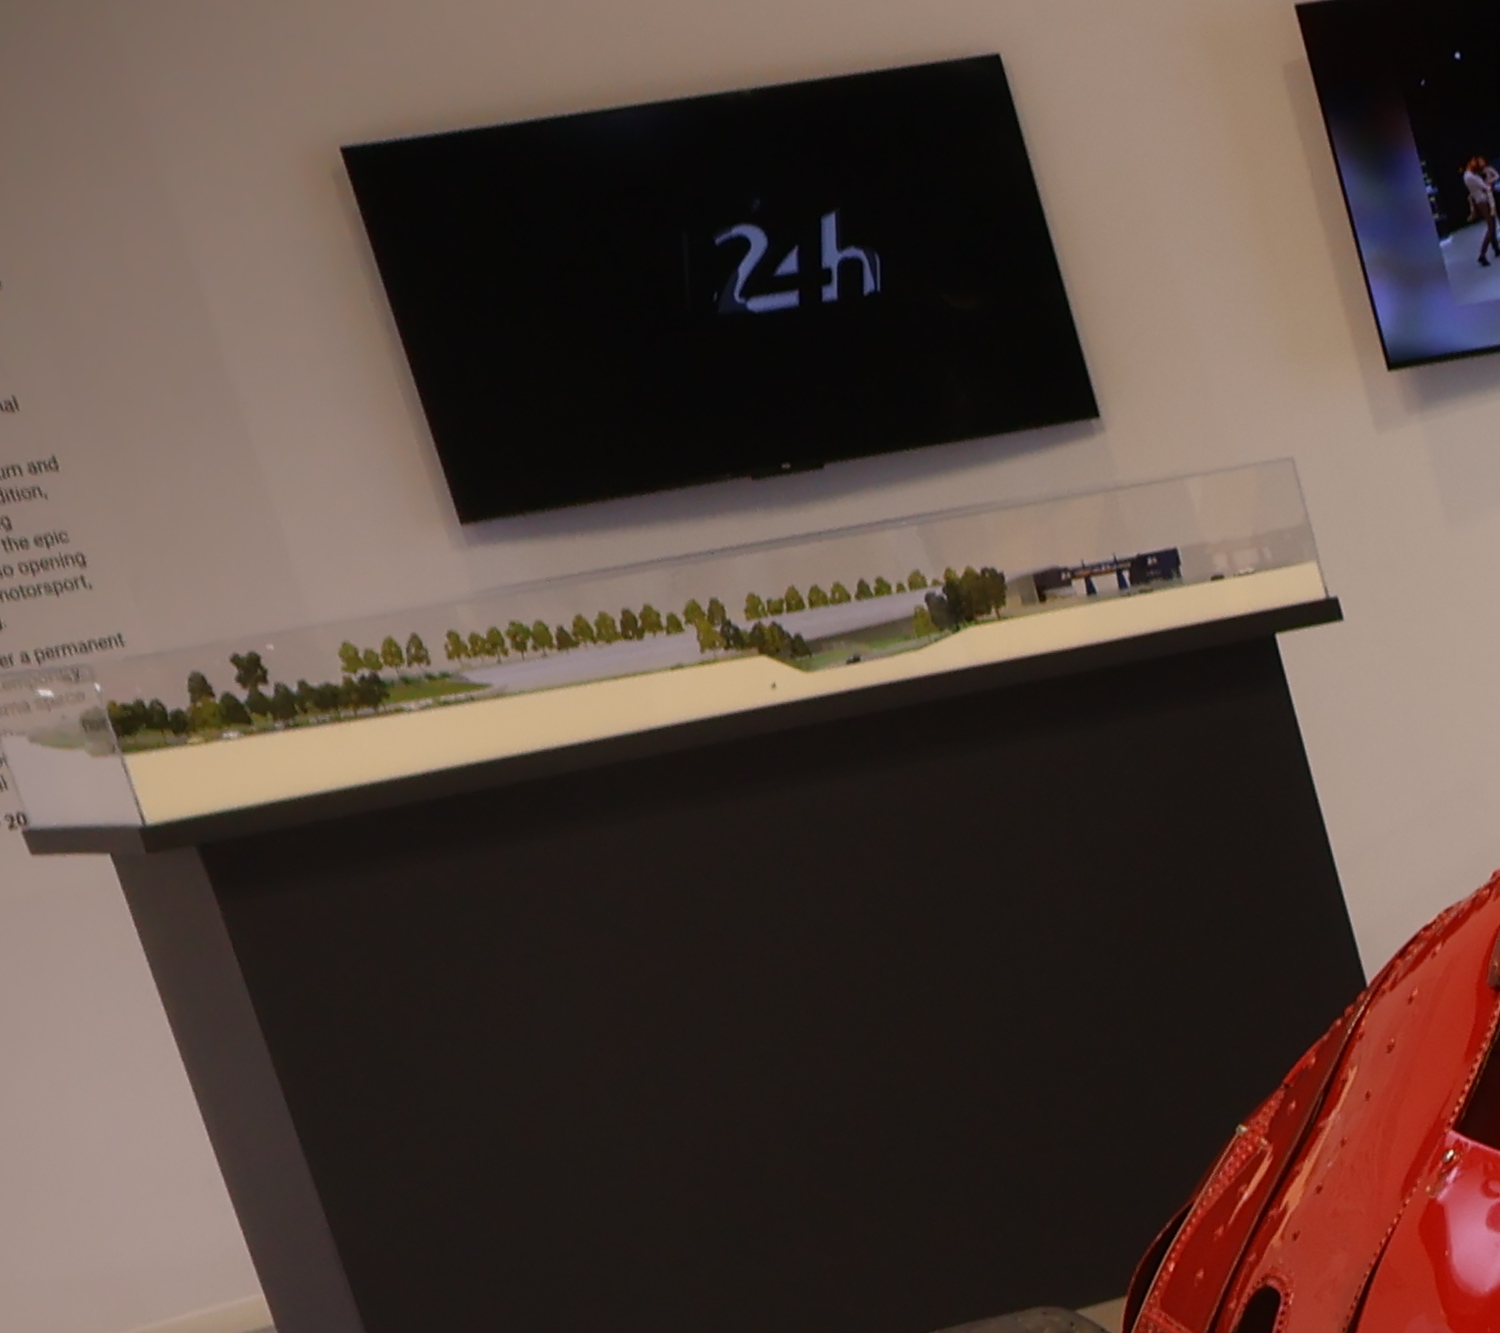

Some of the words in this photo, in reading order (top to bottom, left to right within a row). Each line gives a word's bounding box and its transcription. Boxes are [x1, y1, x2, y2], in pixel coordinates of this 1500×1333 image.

[714, 208, 881, 313] 24h
[27, 454, 59, 475] and
[2, 536, 30, 553] the
[34, 530, 70, 550] epic
[18, 551, 87, 576] opening
[20, 651, 30, 664] a
[34, 632, 125, 666] permanent
